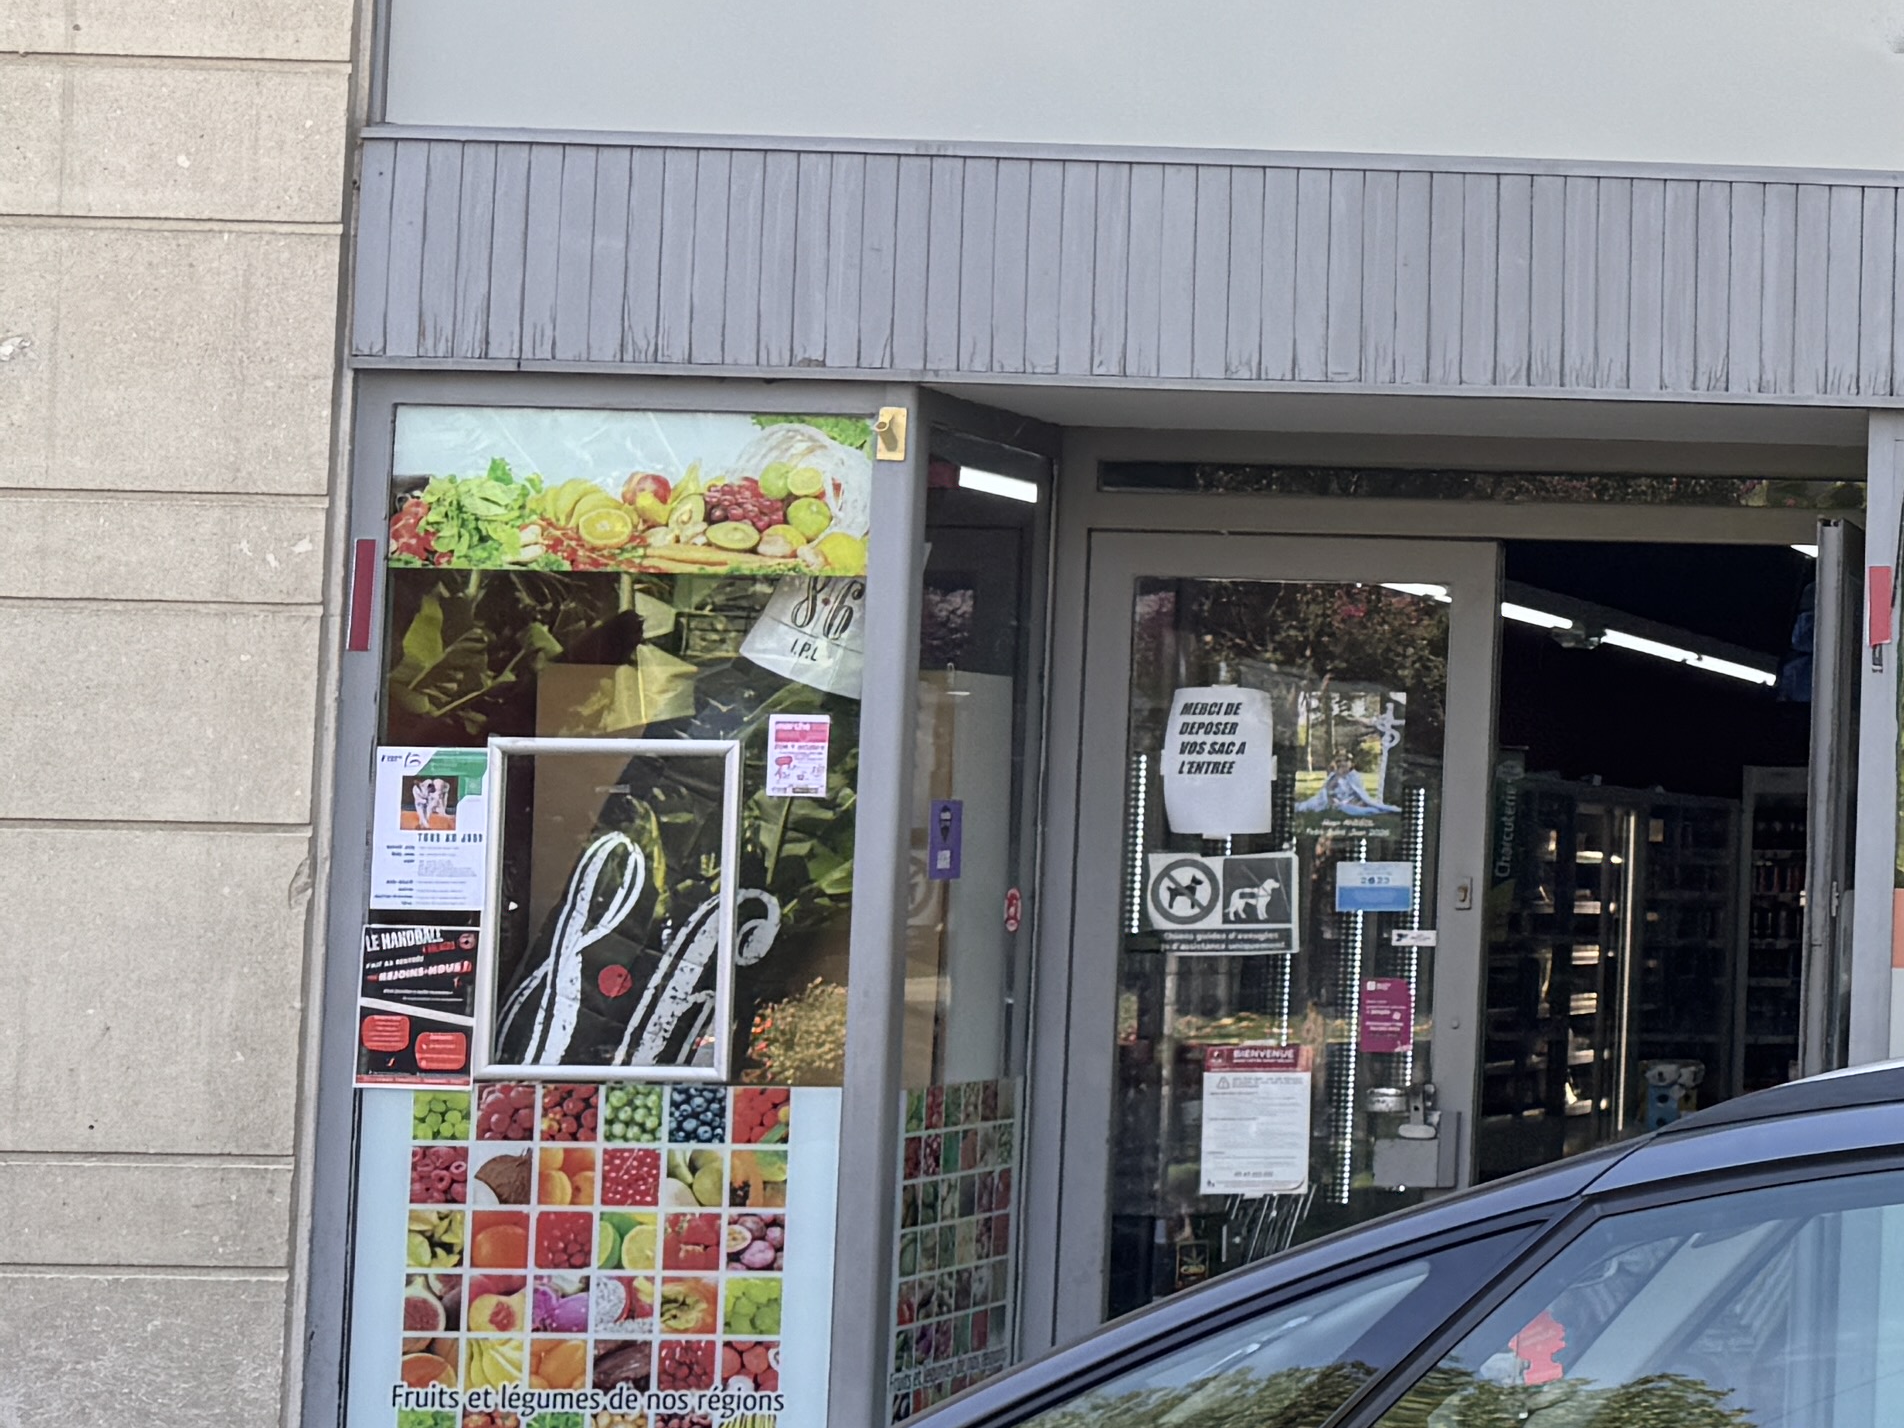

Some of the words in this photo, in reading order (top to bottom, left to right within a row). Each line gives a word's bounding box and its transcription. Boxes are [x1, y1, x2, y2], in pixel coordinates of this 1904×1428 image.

[1180, 702, 1223, 716] MERCI
[1224, 702, 1242, 716] DE
[1179, 741, 1207, 755] VOS
[1208, 741, 1236, 755] SAC
[1235, 741, 1247, 755] A
[365, 934, 380, 952] LE
[1233, 1049, 1294, 1059] BIENVENUE
[392, 1384, 460, 1409] Fruits
[467, 1389, 496, 1411] et
[500, 1385, 599, 1418] légumes
[604, 1386, 638, 1412] de
[647, 1392, 693, 1412] nos
[696, 1387, 786, 1420] régions
